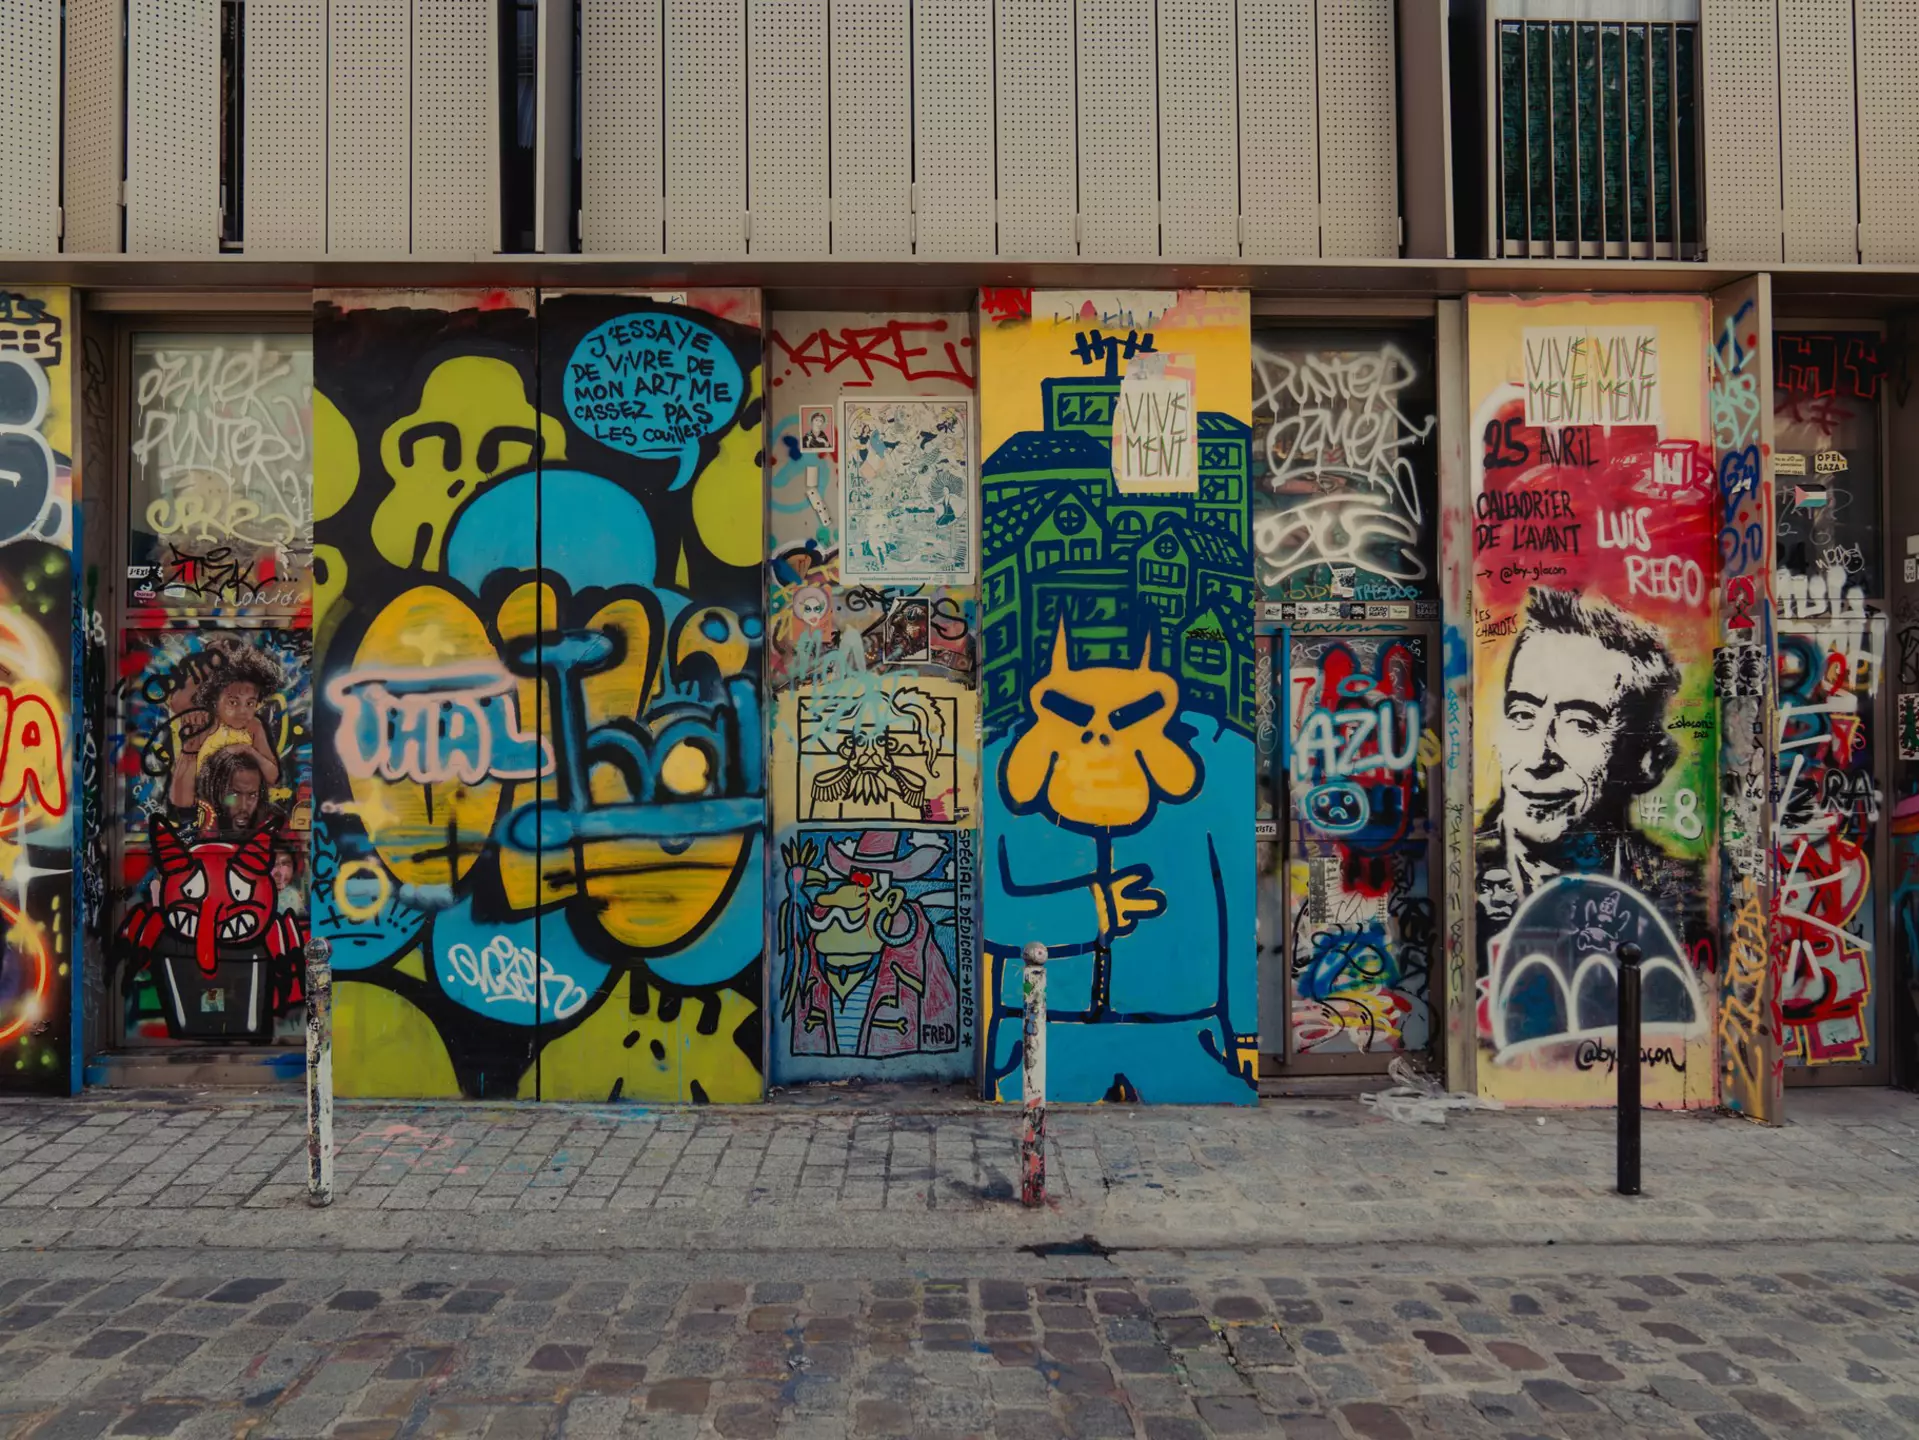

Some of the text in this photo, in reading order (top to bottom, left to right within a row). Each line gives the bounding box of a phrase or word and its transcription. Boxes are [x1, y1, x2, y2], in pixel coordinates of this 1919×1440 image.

[587, 318, 713, 358] J'ESSAYE
[571, 363, 601, 384] DE
[687, 354, 715, 376] DE
[1527, 336, 1656, 381] VIVE VIVE
[574, 372, 732, 404] MON ART, ME
[1529, 380, 1657, 423] MENT MENT
[574, 400, 713, 425] CASSEZ PAS
[1124, 392, 1188, 434] VIVE
[594, 424, 638, 446] LES
[1484, 416, 1529, 470] 25
[1126, 435, 1188, 478] MENT
[1476, 524, 1581, 555] DE L'AVANT
[1624, 554, 1704, 608] REGO
[1475, 608, 1491, 624] LES
[1297, 702, 1420, 780] AZU
[922, 1023, 955, 1045] FRED
